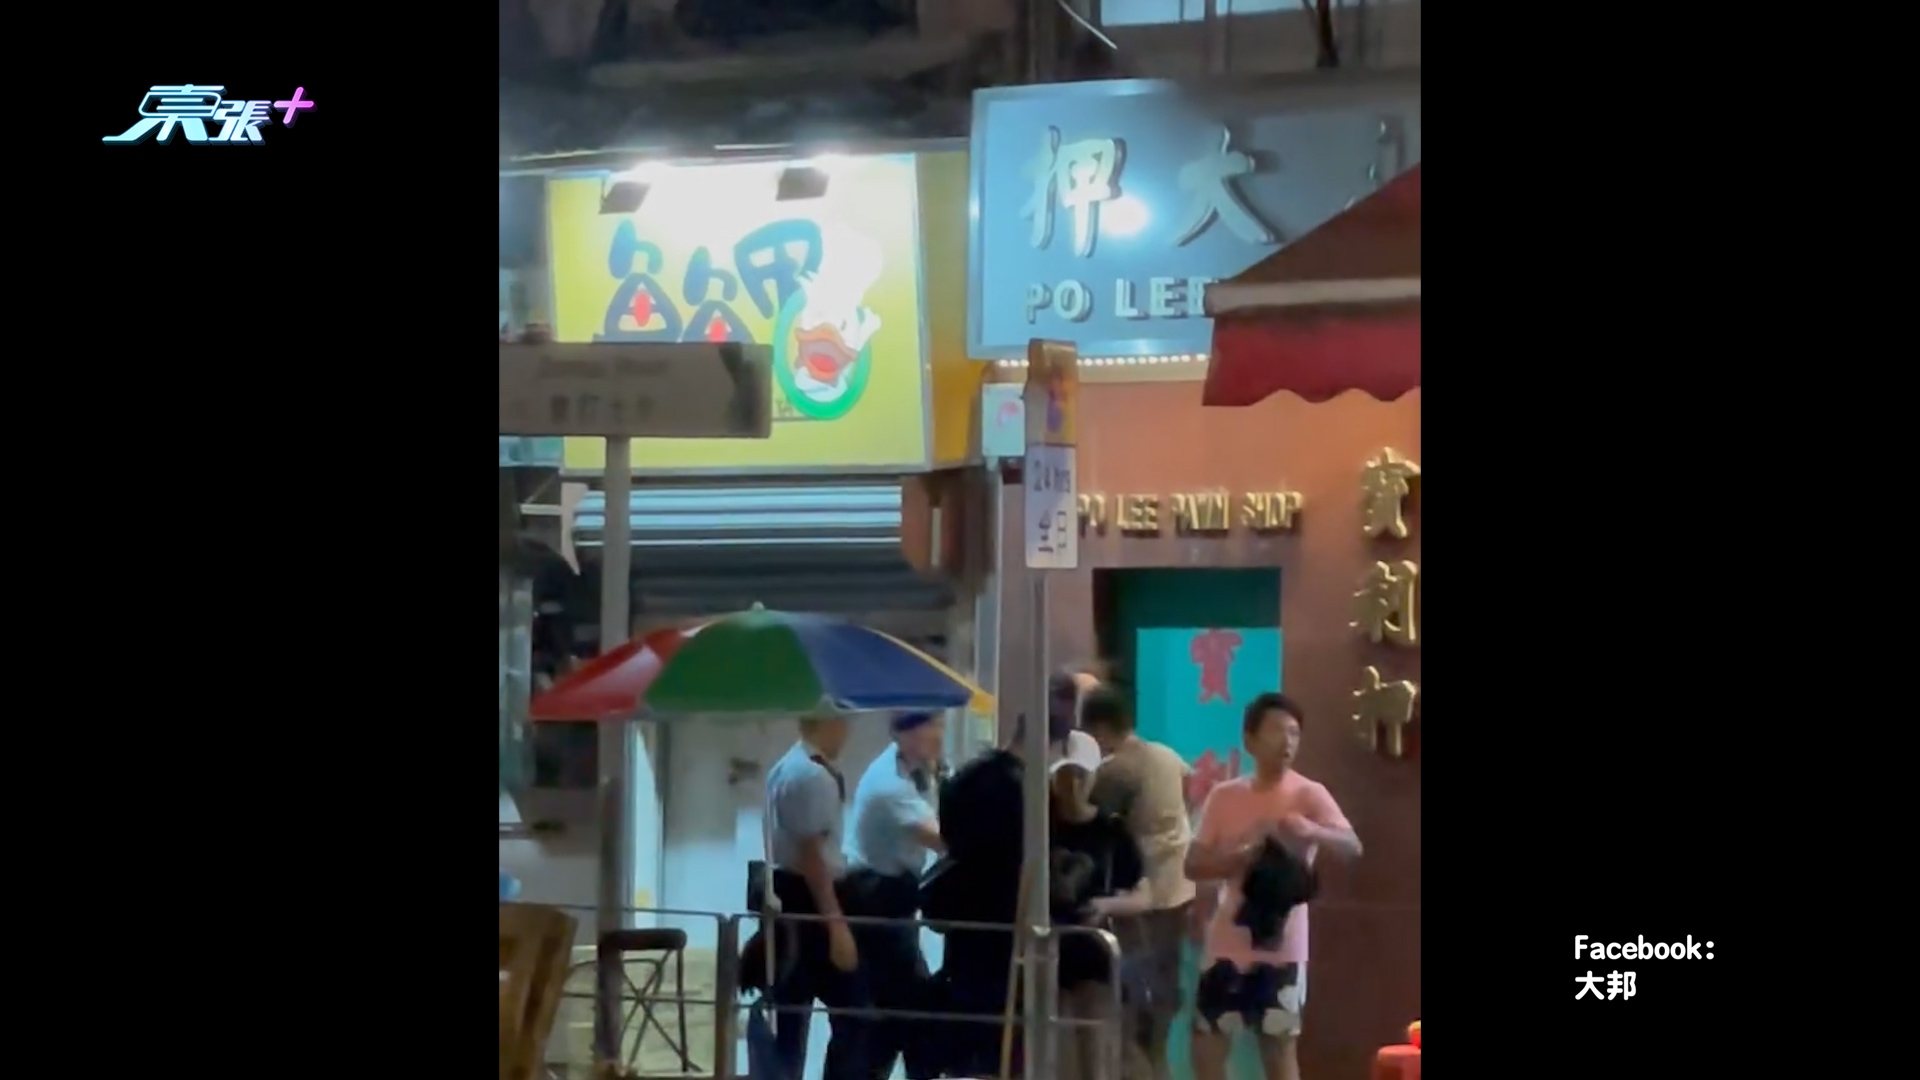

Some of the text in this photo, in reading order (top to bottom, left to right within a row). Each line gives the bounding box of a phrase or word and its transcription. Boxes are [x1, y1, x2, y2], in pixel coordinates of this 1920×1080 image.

[1027, 280, 1093, 324] PO
[1116, 493, 1160, 531] LEE
[1241, 490, 1303, 530] SHOP
